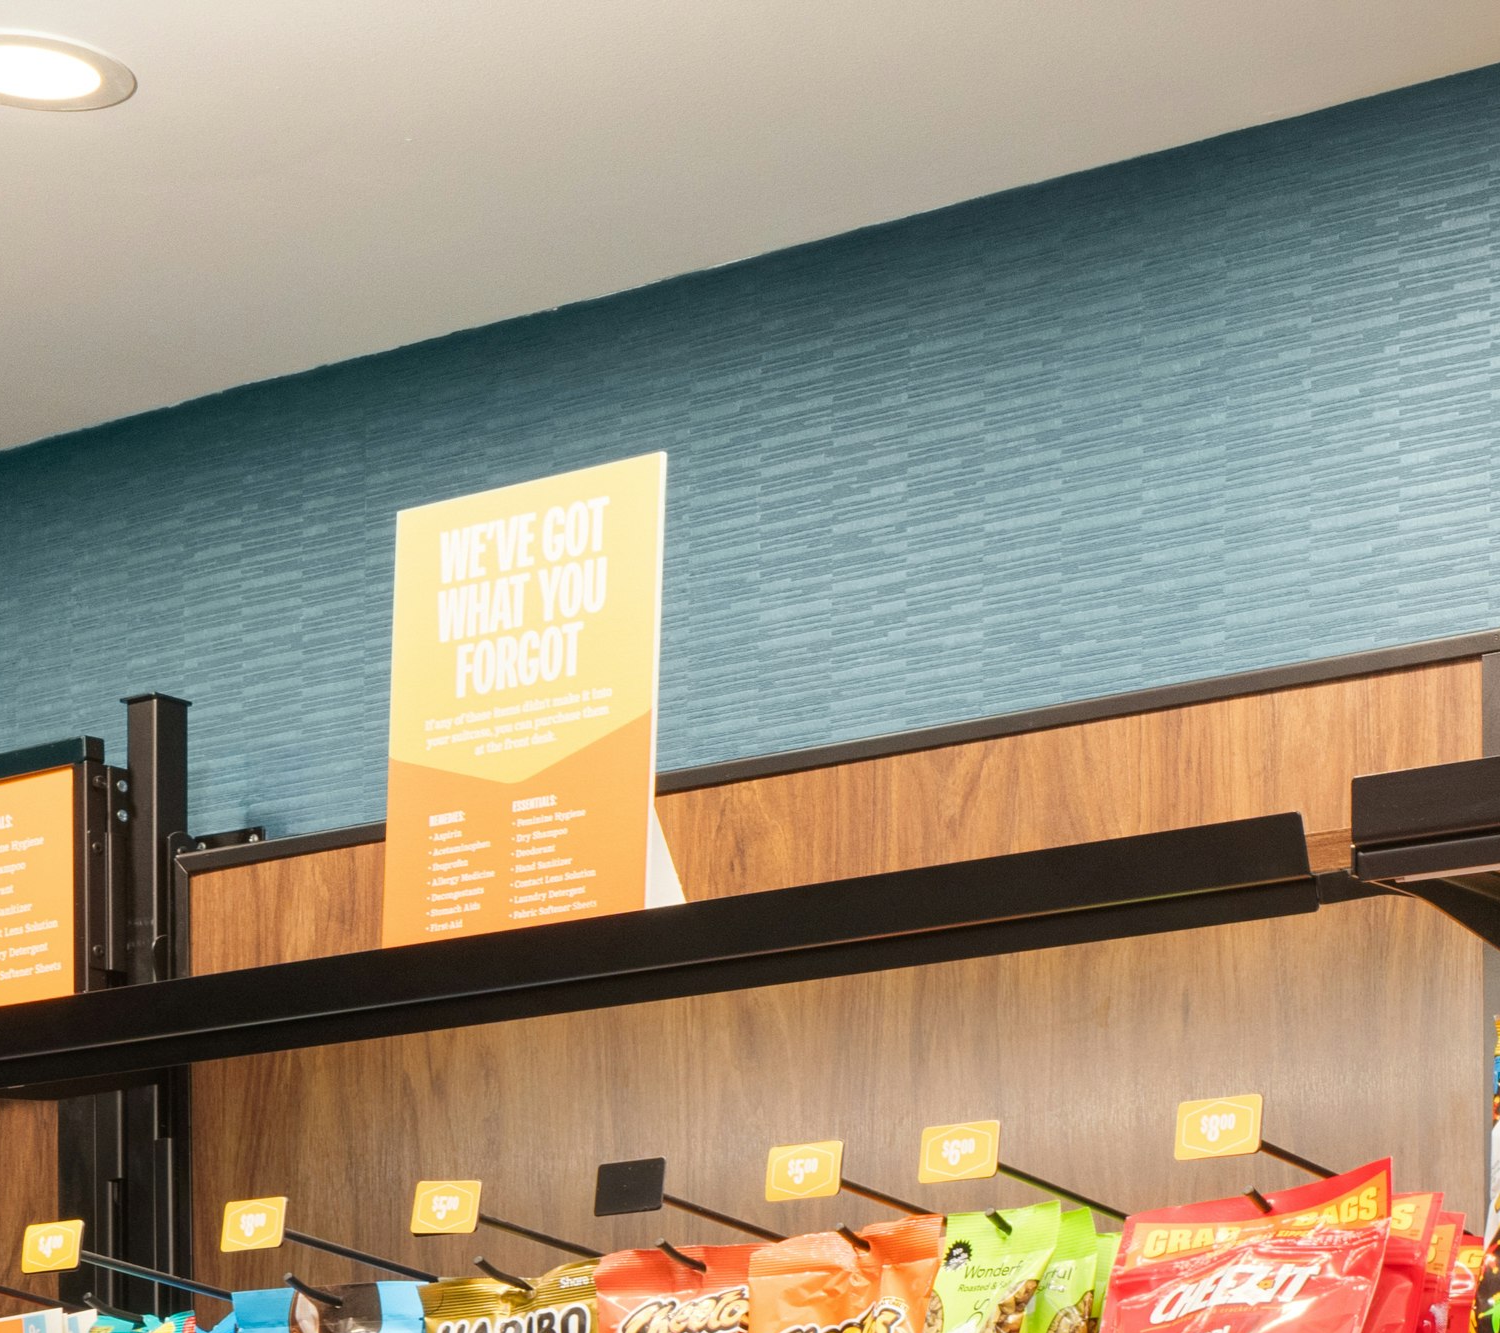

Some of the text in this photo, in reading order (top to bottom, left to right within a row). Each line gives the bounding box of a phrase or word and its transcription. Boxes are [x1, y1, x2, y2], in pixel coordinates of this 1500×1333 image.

[439, 495, 609, 584] WE'VE GOT
[437, 557, 607, 643] WHAT YOU
[455, 621, 584, 699] FORGOT
